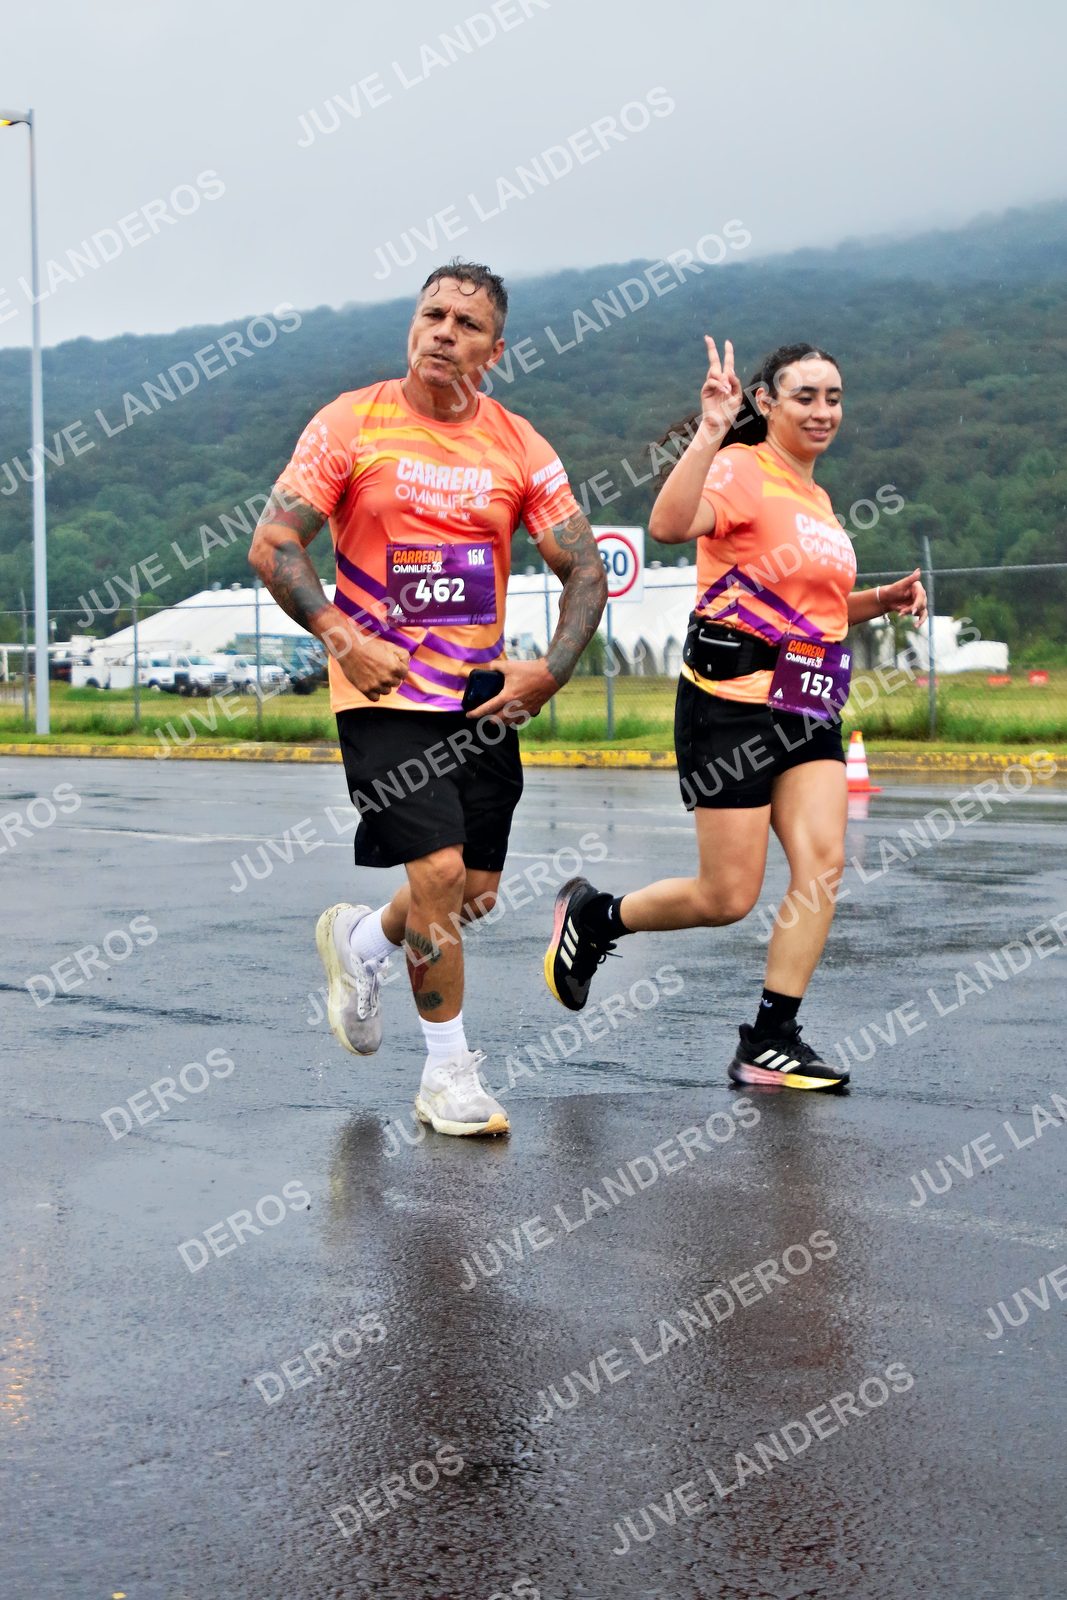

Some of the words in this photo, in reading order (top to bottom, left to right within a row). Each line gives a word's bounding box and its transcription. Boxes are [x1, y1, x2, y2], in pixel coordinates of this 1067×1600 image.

[396, 457, 493, 491] CARRERA
[394, 483, 469, 510] OMNILIFE
[393, 550, 443, 564] CARRERA
[393, 564, 432, 573] OMNILIFE
[415, 577, 466, 603] 462
[785, 652, 816, 668] OMNILIFE
[788, 640, 826, 659] CARRERA
[800, 671, 834, 699] 152
